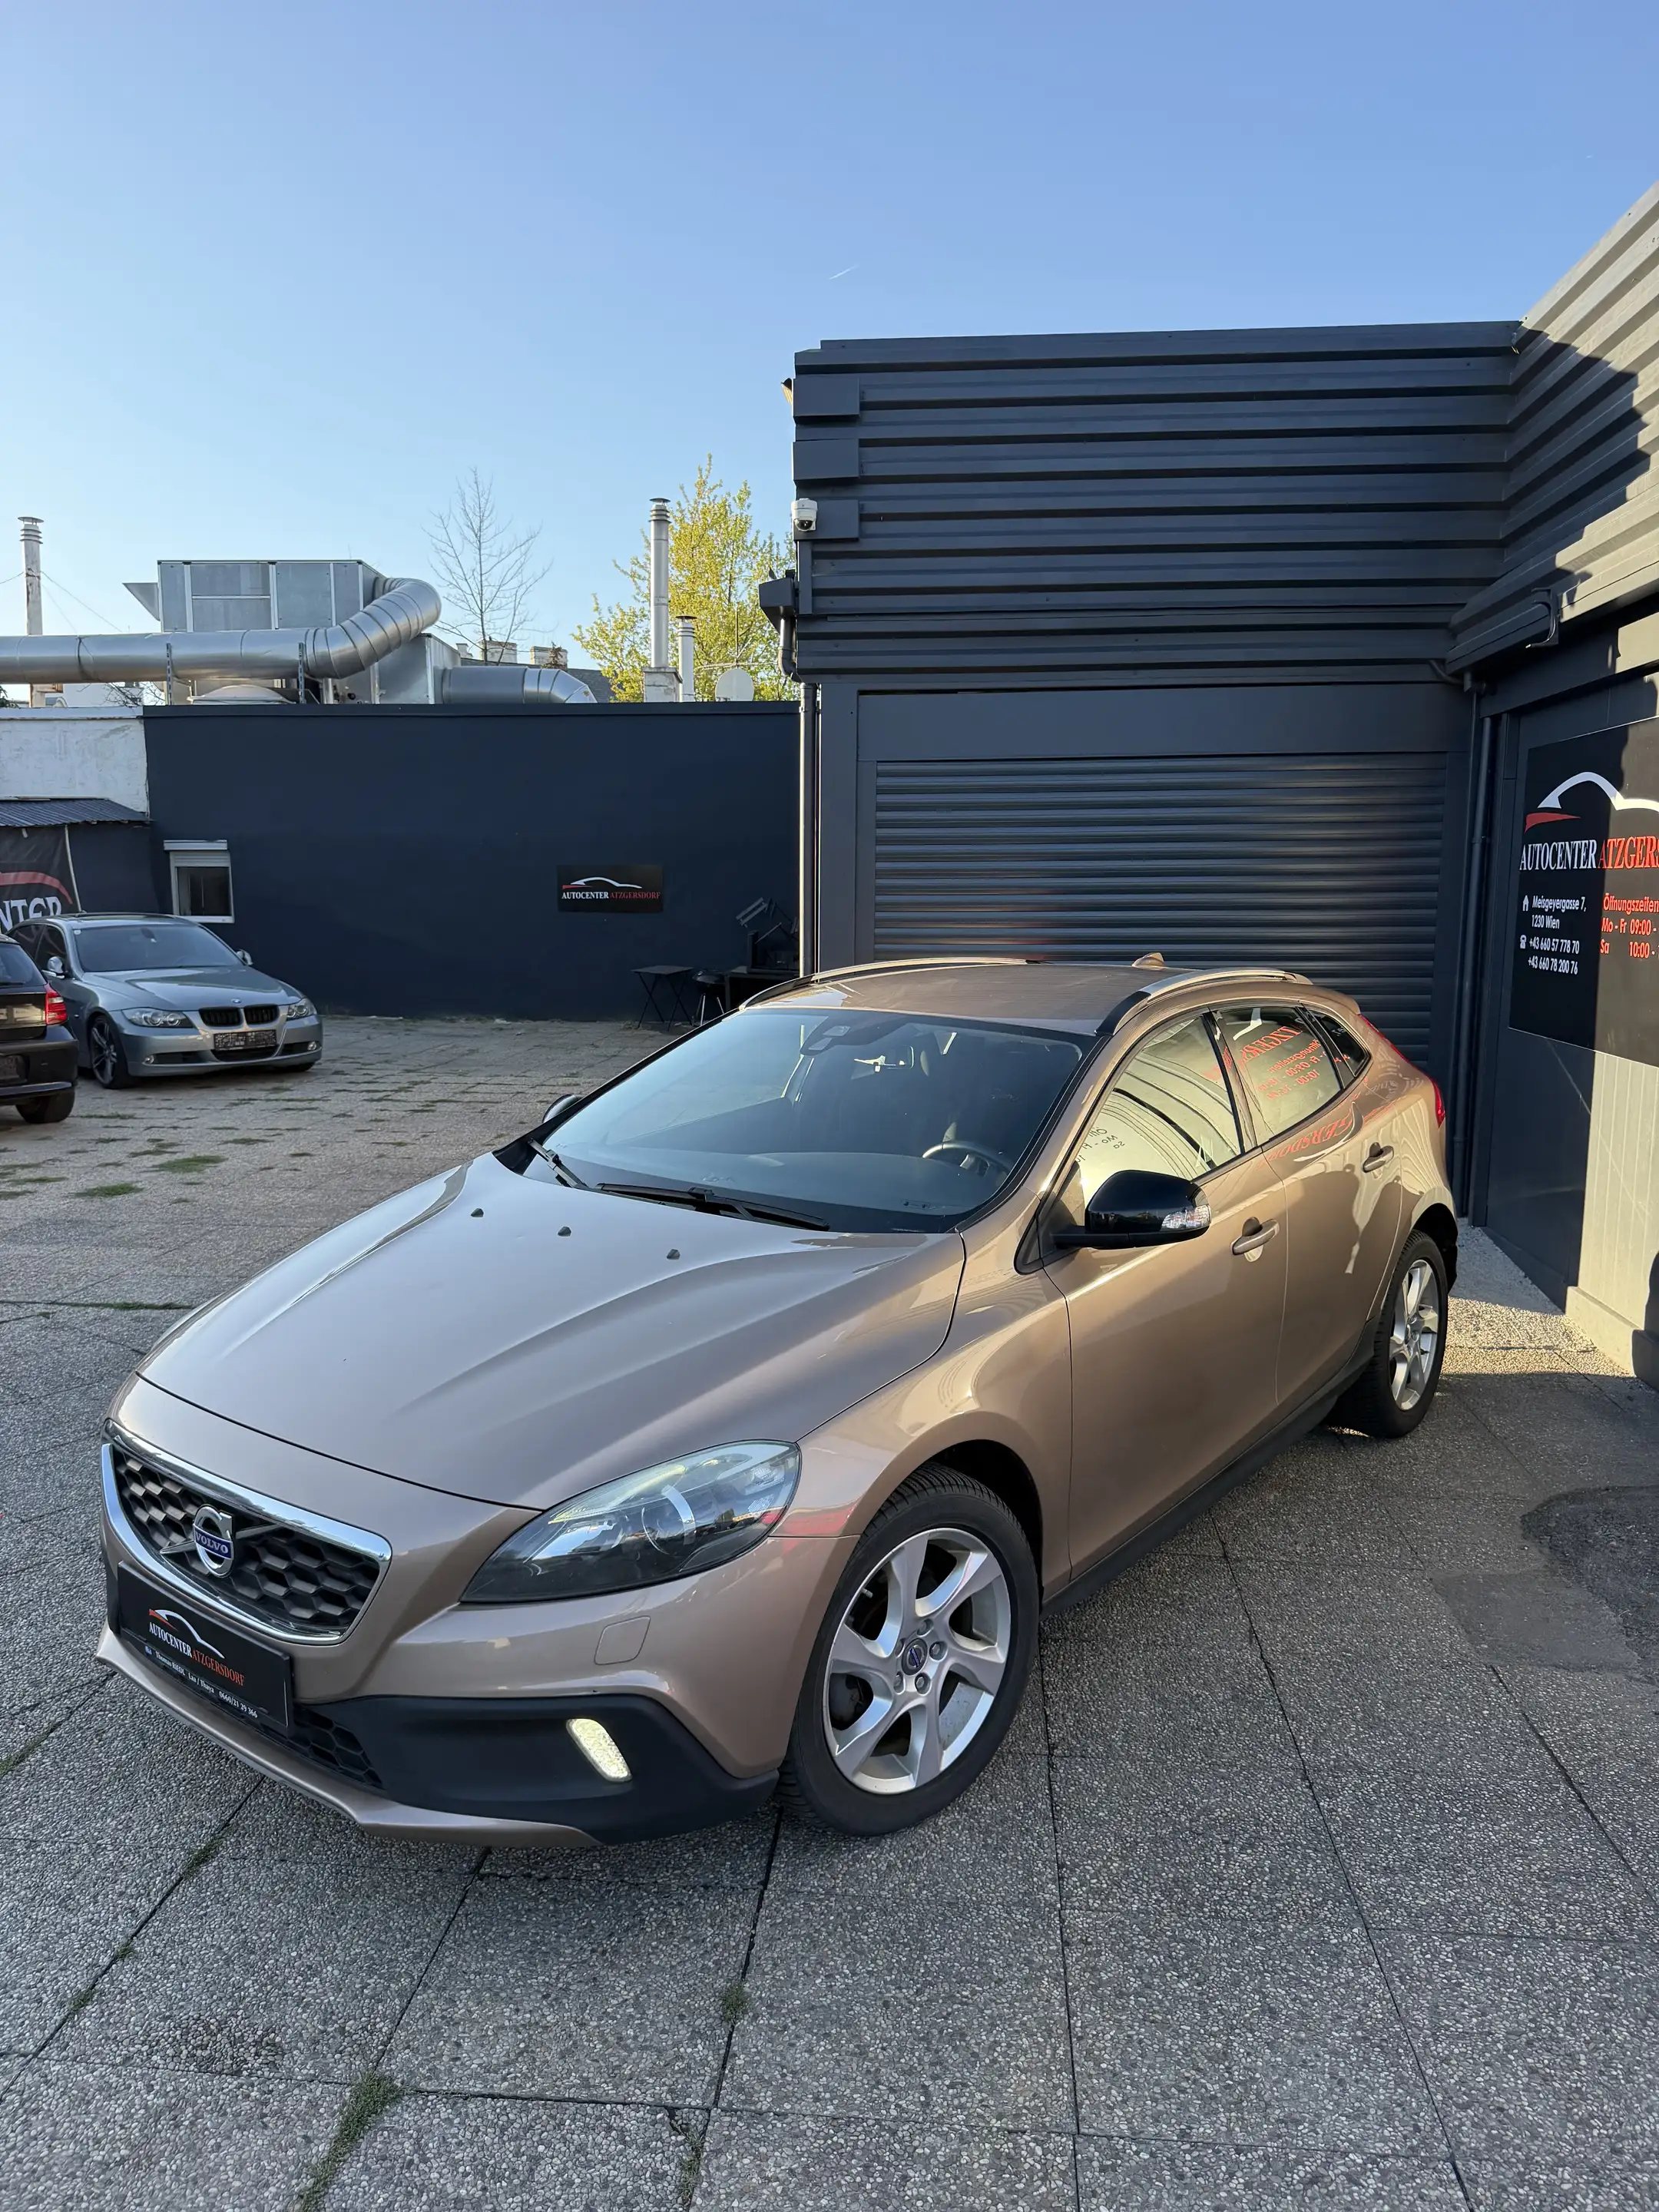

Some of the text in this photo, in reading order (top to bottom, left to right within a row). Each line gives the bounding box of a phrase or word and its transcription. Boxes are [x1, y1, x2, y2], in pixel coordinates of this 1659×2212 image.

[1519, 839, 1597, 870] AUTOCENTER
[561, 891, 661, 899] AUTOCENTER ATZGERSDORF
[1532, 914, 1560, 929] 1230 Wien
[1601, 918, 1613, 932] Mo
[1619, 919, 1627, 933] Fr
[1630, 919, 1651, 935] 09:00
[1529, 936, 1580, 955] +43 660 57 778 70
[1600, 939, 1610, 954] Sa
[1629, 942, 1650, 959] 10:00
[1528, 955, 1578, 975] +43 660 78 200 76
[195, 1532, 229, 1554] VOLVO
[149, 1621, 245, 1687] AUTOCENTER ATZGERSDORF
